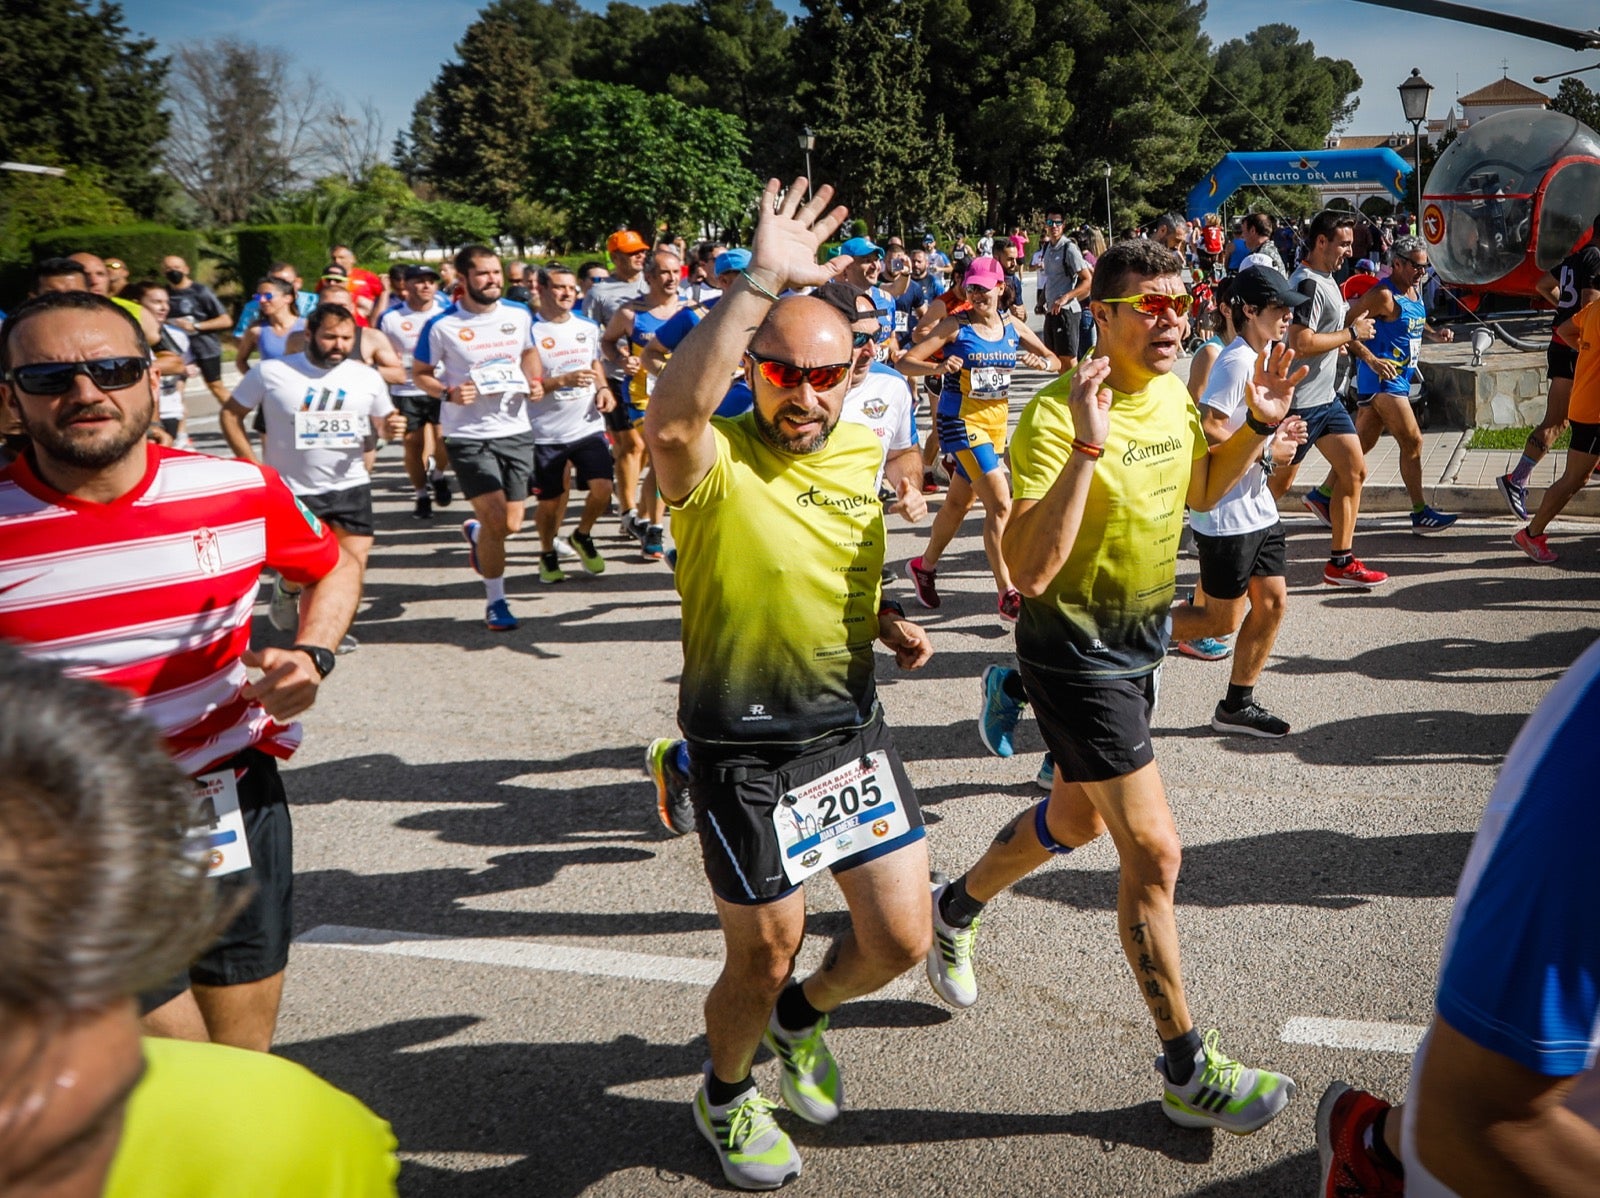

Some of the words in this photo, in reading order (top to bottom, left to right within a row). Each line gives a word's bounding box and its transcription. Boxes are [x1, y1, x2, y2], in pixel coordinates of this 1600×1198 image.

[1251, 171, 1300, 181] EJÉRCITO
[1306, 172, 1326, 180] DEL
[1333, 170, 1359, 180] AIRE
[991, 373, 1004, 387] 99
[318, 419, 351, 433] 283
[1122, 435, 1182, 466] Carmela
[797, 780, 833, 800] CARRERA
[834, 771, 853, 783] BASE
[817, 775, 882, 828] 205
